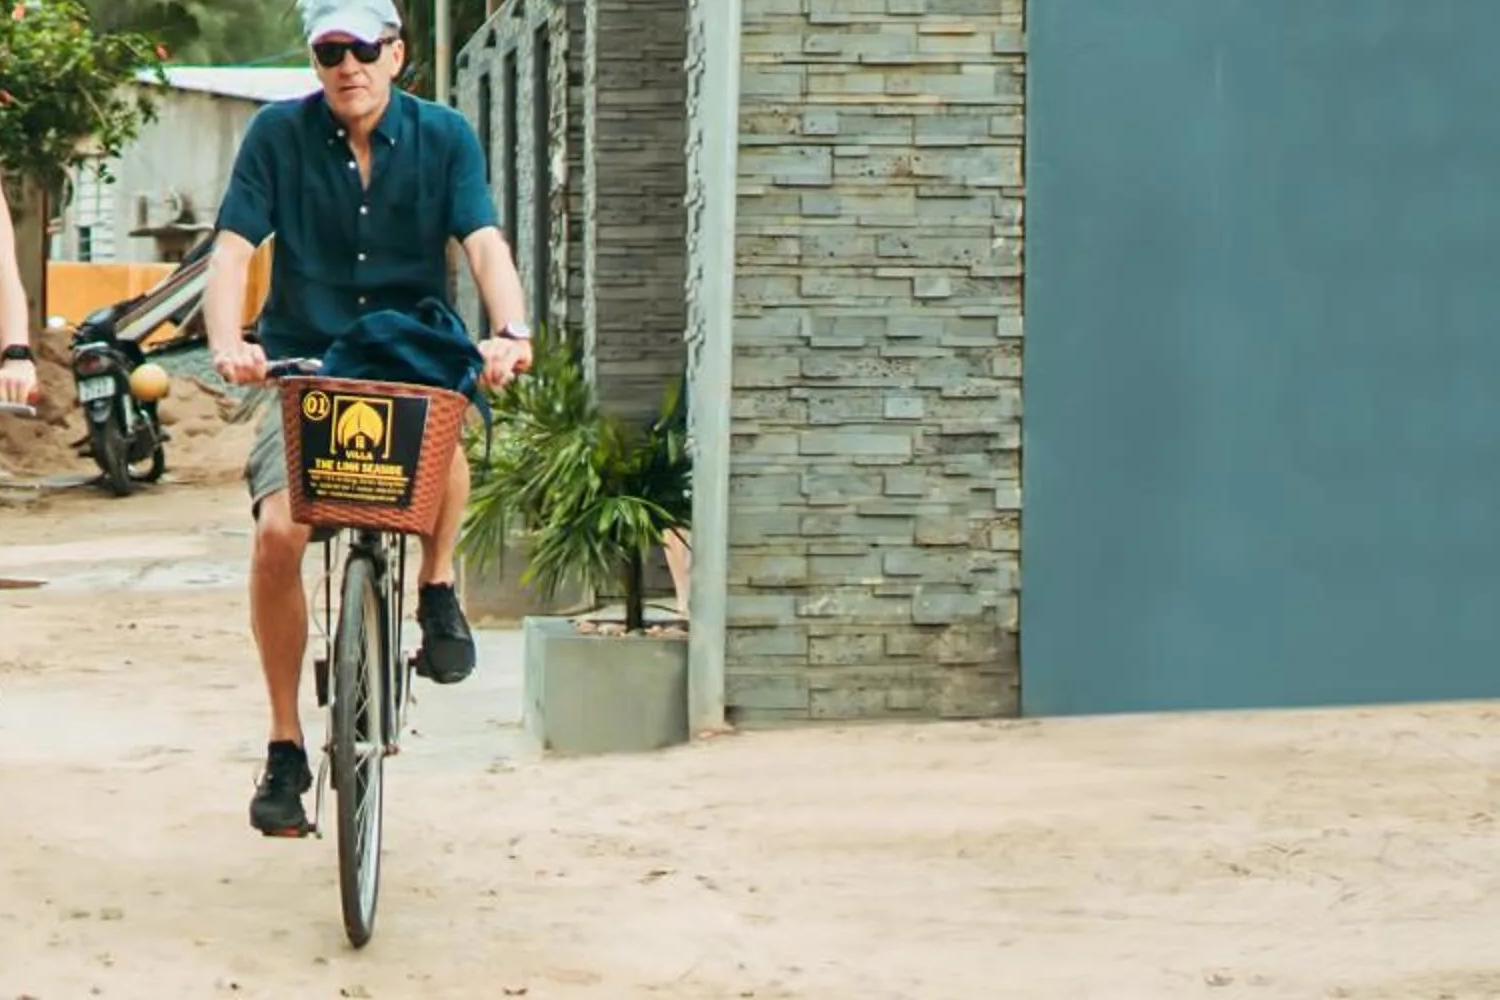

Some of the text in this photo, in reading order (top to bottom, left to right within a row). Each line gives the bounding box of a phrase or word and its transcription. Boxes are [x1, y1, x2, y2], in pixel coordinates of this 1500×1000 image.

[306, 397, 327, 415] 01
[345, 450, 373, 461] VILLA
[315, 458, 335, 470] THE
